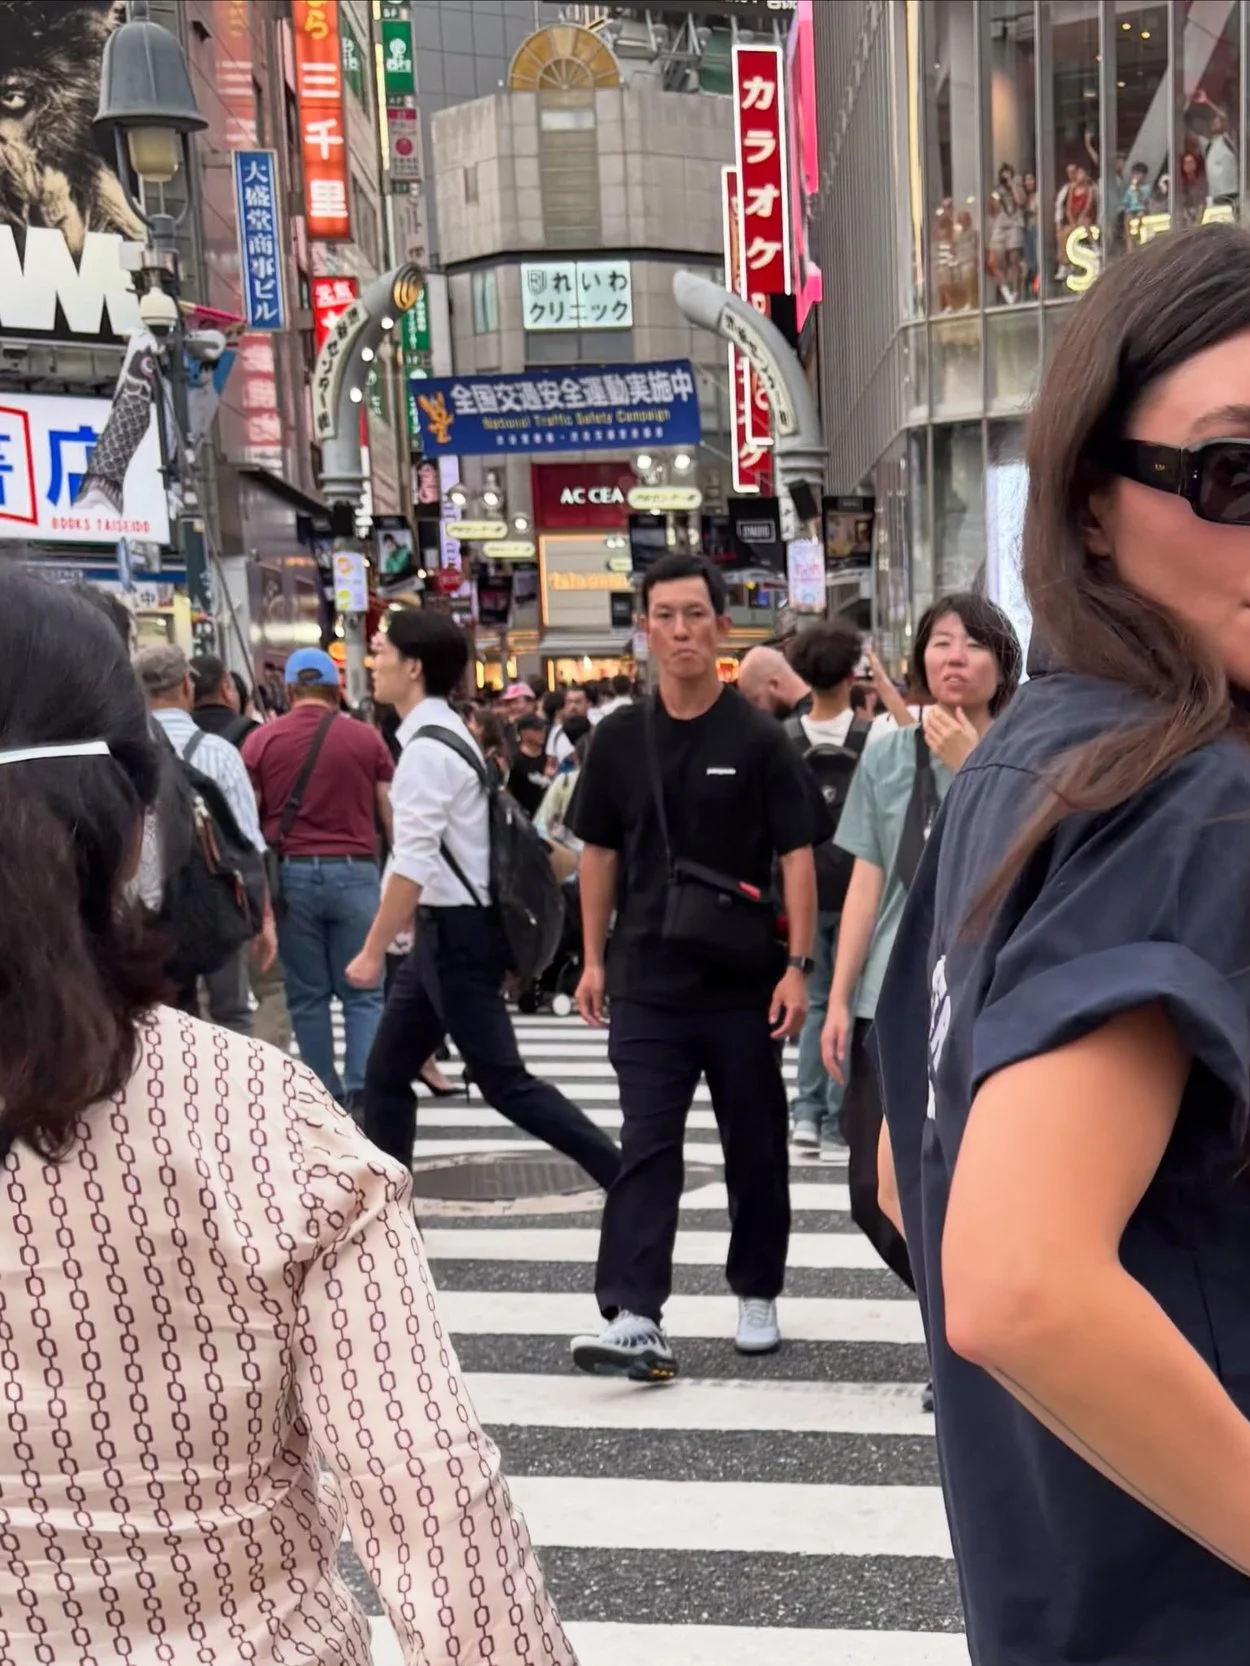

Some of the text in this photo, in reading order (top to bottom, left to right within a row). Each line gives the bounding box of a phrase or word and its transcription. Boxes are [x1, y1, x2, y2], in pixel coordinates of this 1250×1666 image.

[301, 62, 348, 218] 三千里
[741, 76, 782, 270] カラオケ
[244, 160, 278, 321] 大盛堂商事ビル
[553, 270, 628, 294] れいわ
[530, 300, 628, 323] クリニック
[451, 368, 695, 415] 全国交通安全運動実施中
[482, 408, 671, 430] National Traffic Safety Campaign
[51, 517, 151, 534] BOOKS TAISEIDO
